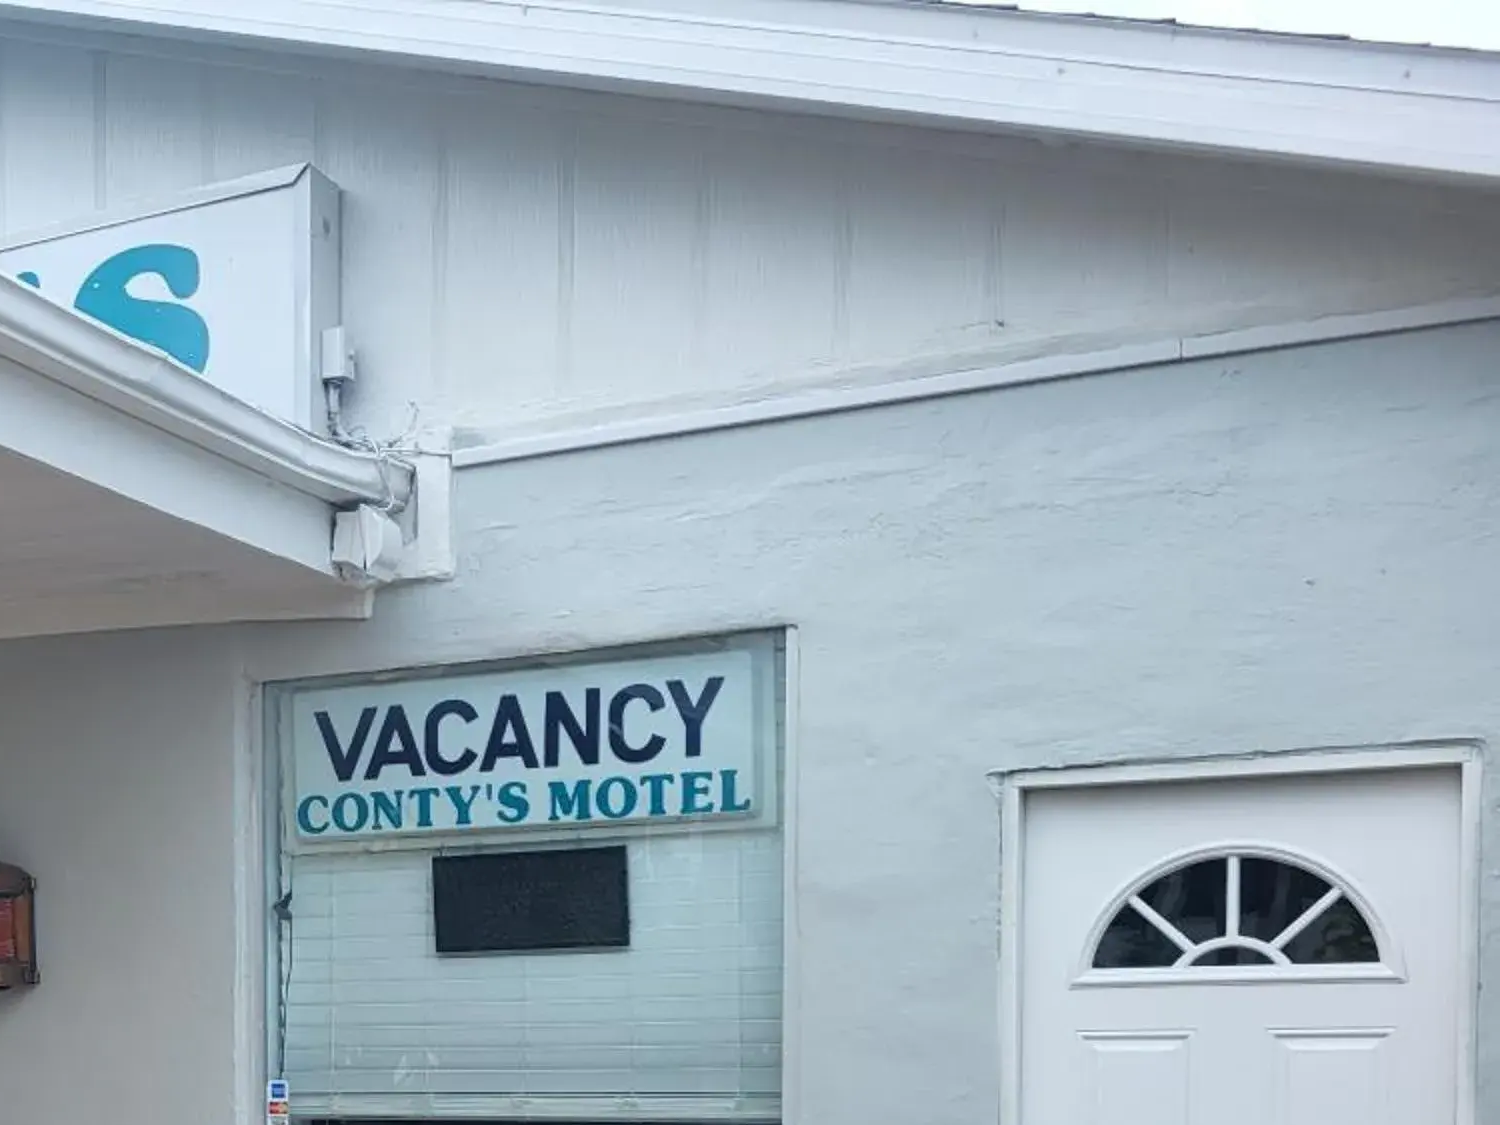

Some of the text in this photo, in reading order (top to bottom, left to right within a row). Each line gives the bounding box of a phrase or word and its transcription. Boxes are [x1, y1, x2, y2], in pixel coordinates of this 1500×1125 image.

[16, 243, 210, 373] S
[313, 676, 725, 781] VACANCY
[297, 769, 751, 834] CONTY'S MOTEL
